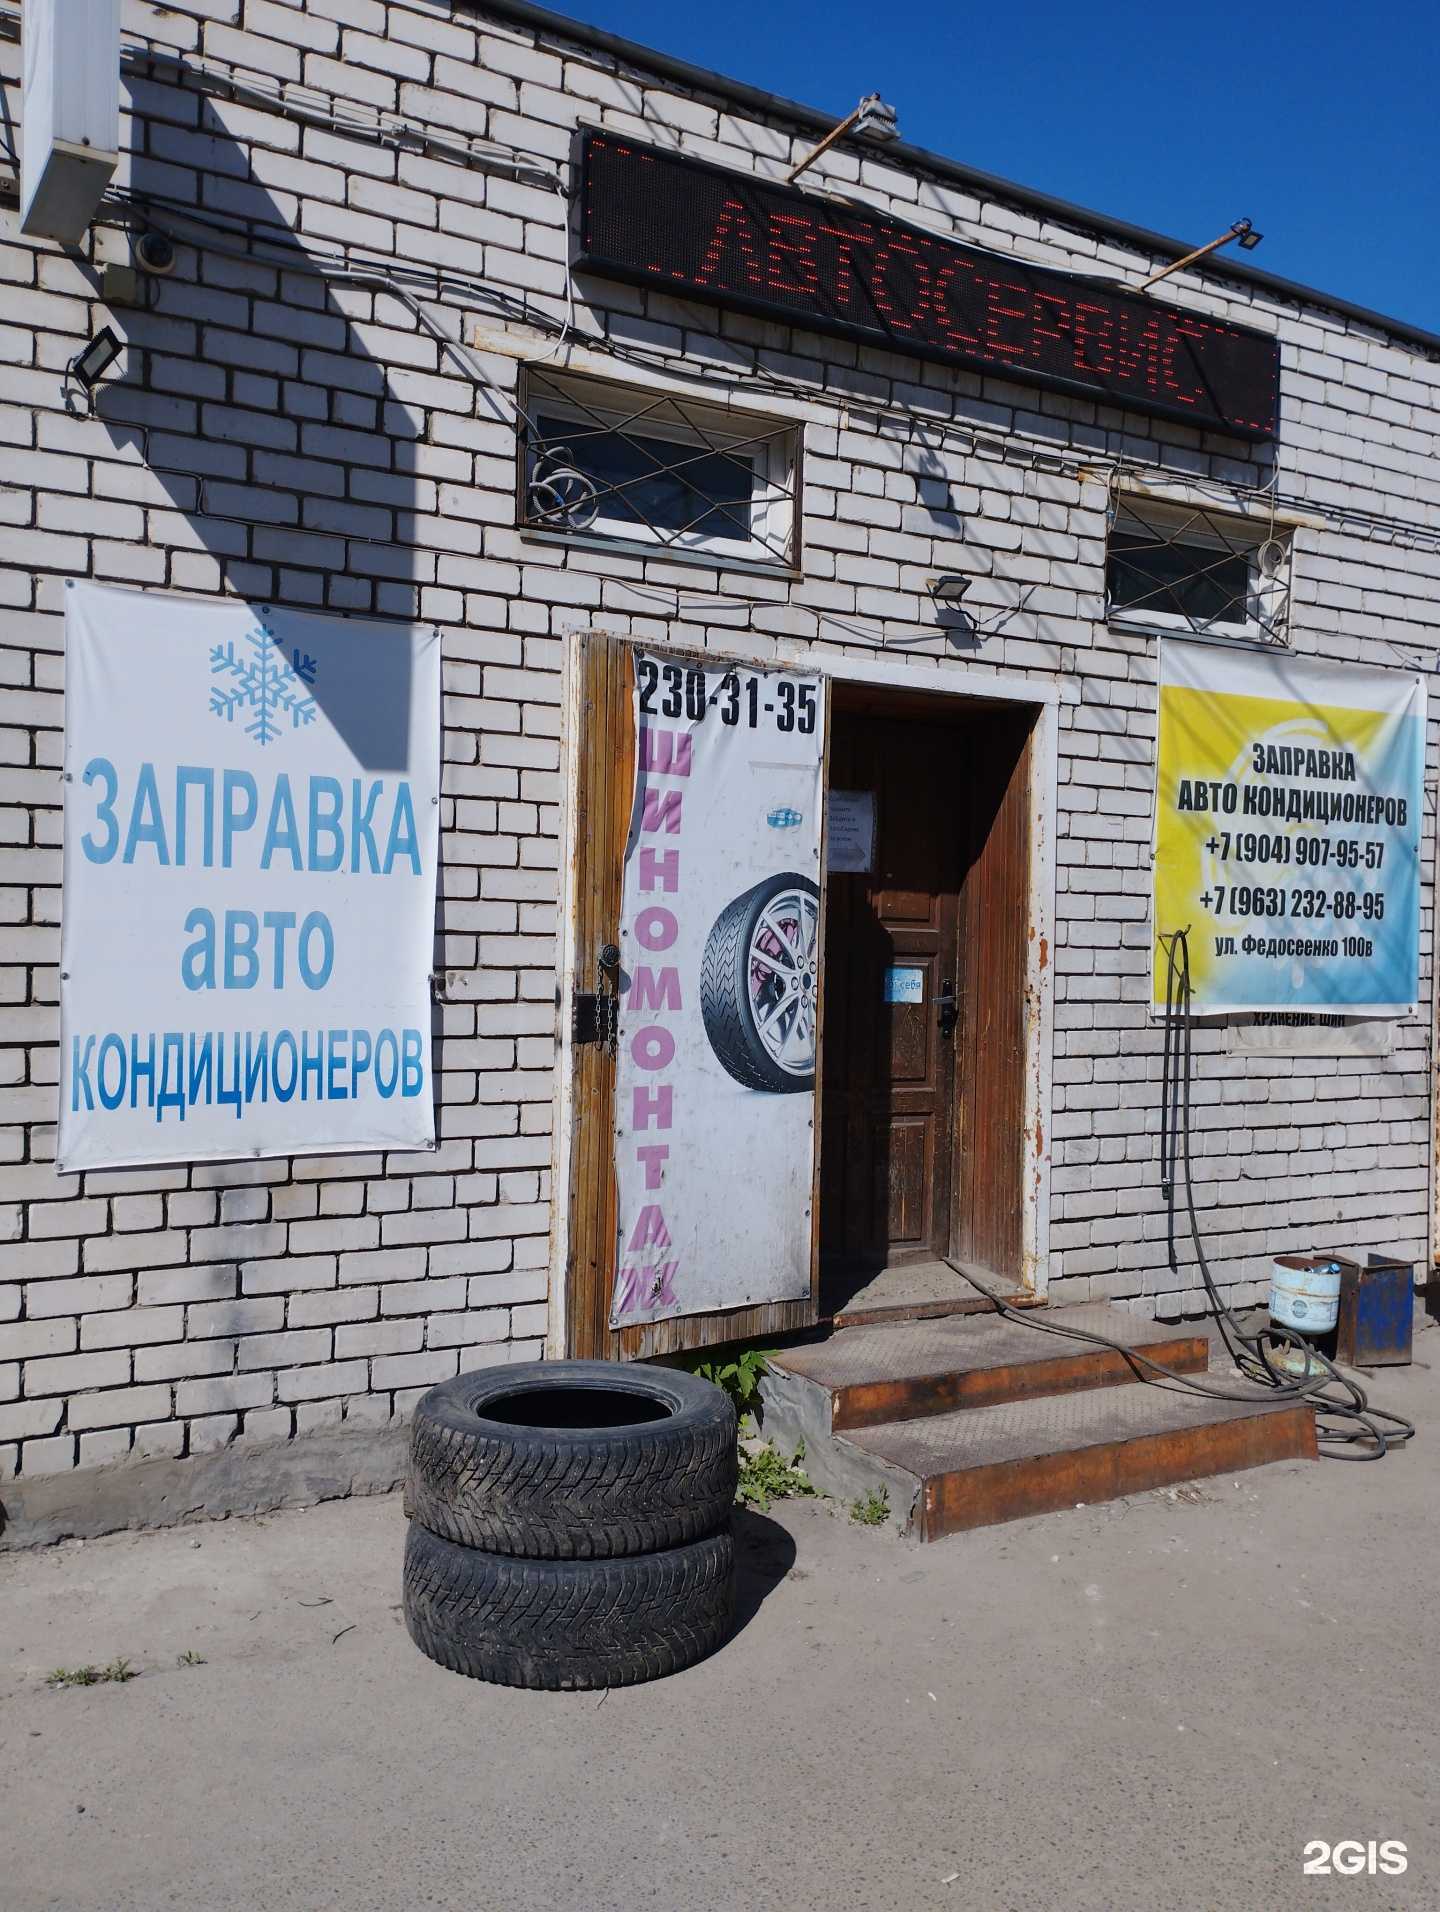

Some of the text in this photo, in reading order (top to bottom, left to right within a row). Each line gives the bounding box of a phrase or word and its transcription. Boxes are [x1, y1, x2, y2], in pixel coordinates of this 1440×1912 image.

[694, 201, 1204, 403] АВТОСЕРВИС
[638, 660, 816, 734] 230-31-35
[1253, 742, 1356, 782] ЗАПРАВКА
[80, 757, 423, 876] ЗАПРАВКА
[1177, 780, 1408, 826] АВТО КОНДИЦИОНЕРОВ
[1206, 832, 1384, 869] +7 (904) 907-95-57
[1200, 886, 1384, 920] +7 (963) 232-88-95
[180, 907, 335, 991] авто
[1215, 934, 1373, 959] ул. Федосеенко 100в
[619, 726, 692, 1314] ШИНОМОНТАЖ
[71, 1028, 424, 1123] КОНДИЦИОНЕРОВ
